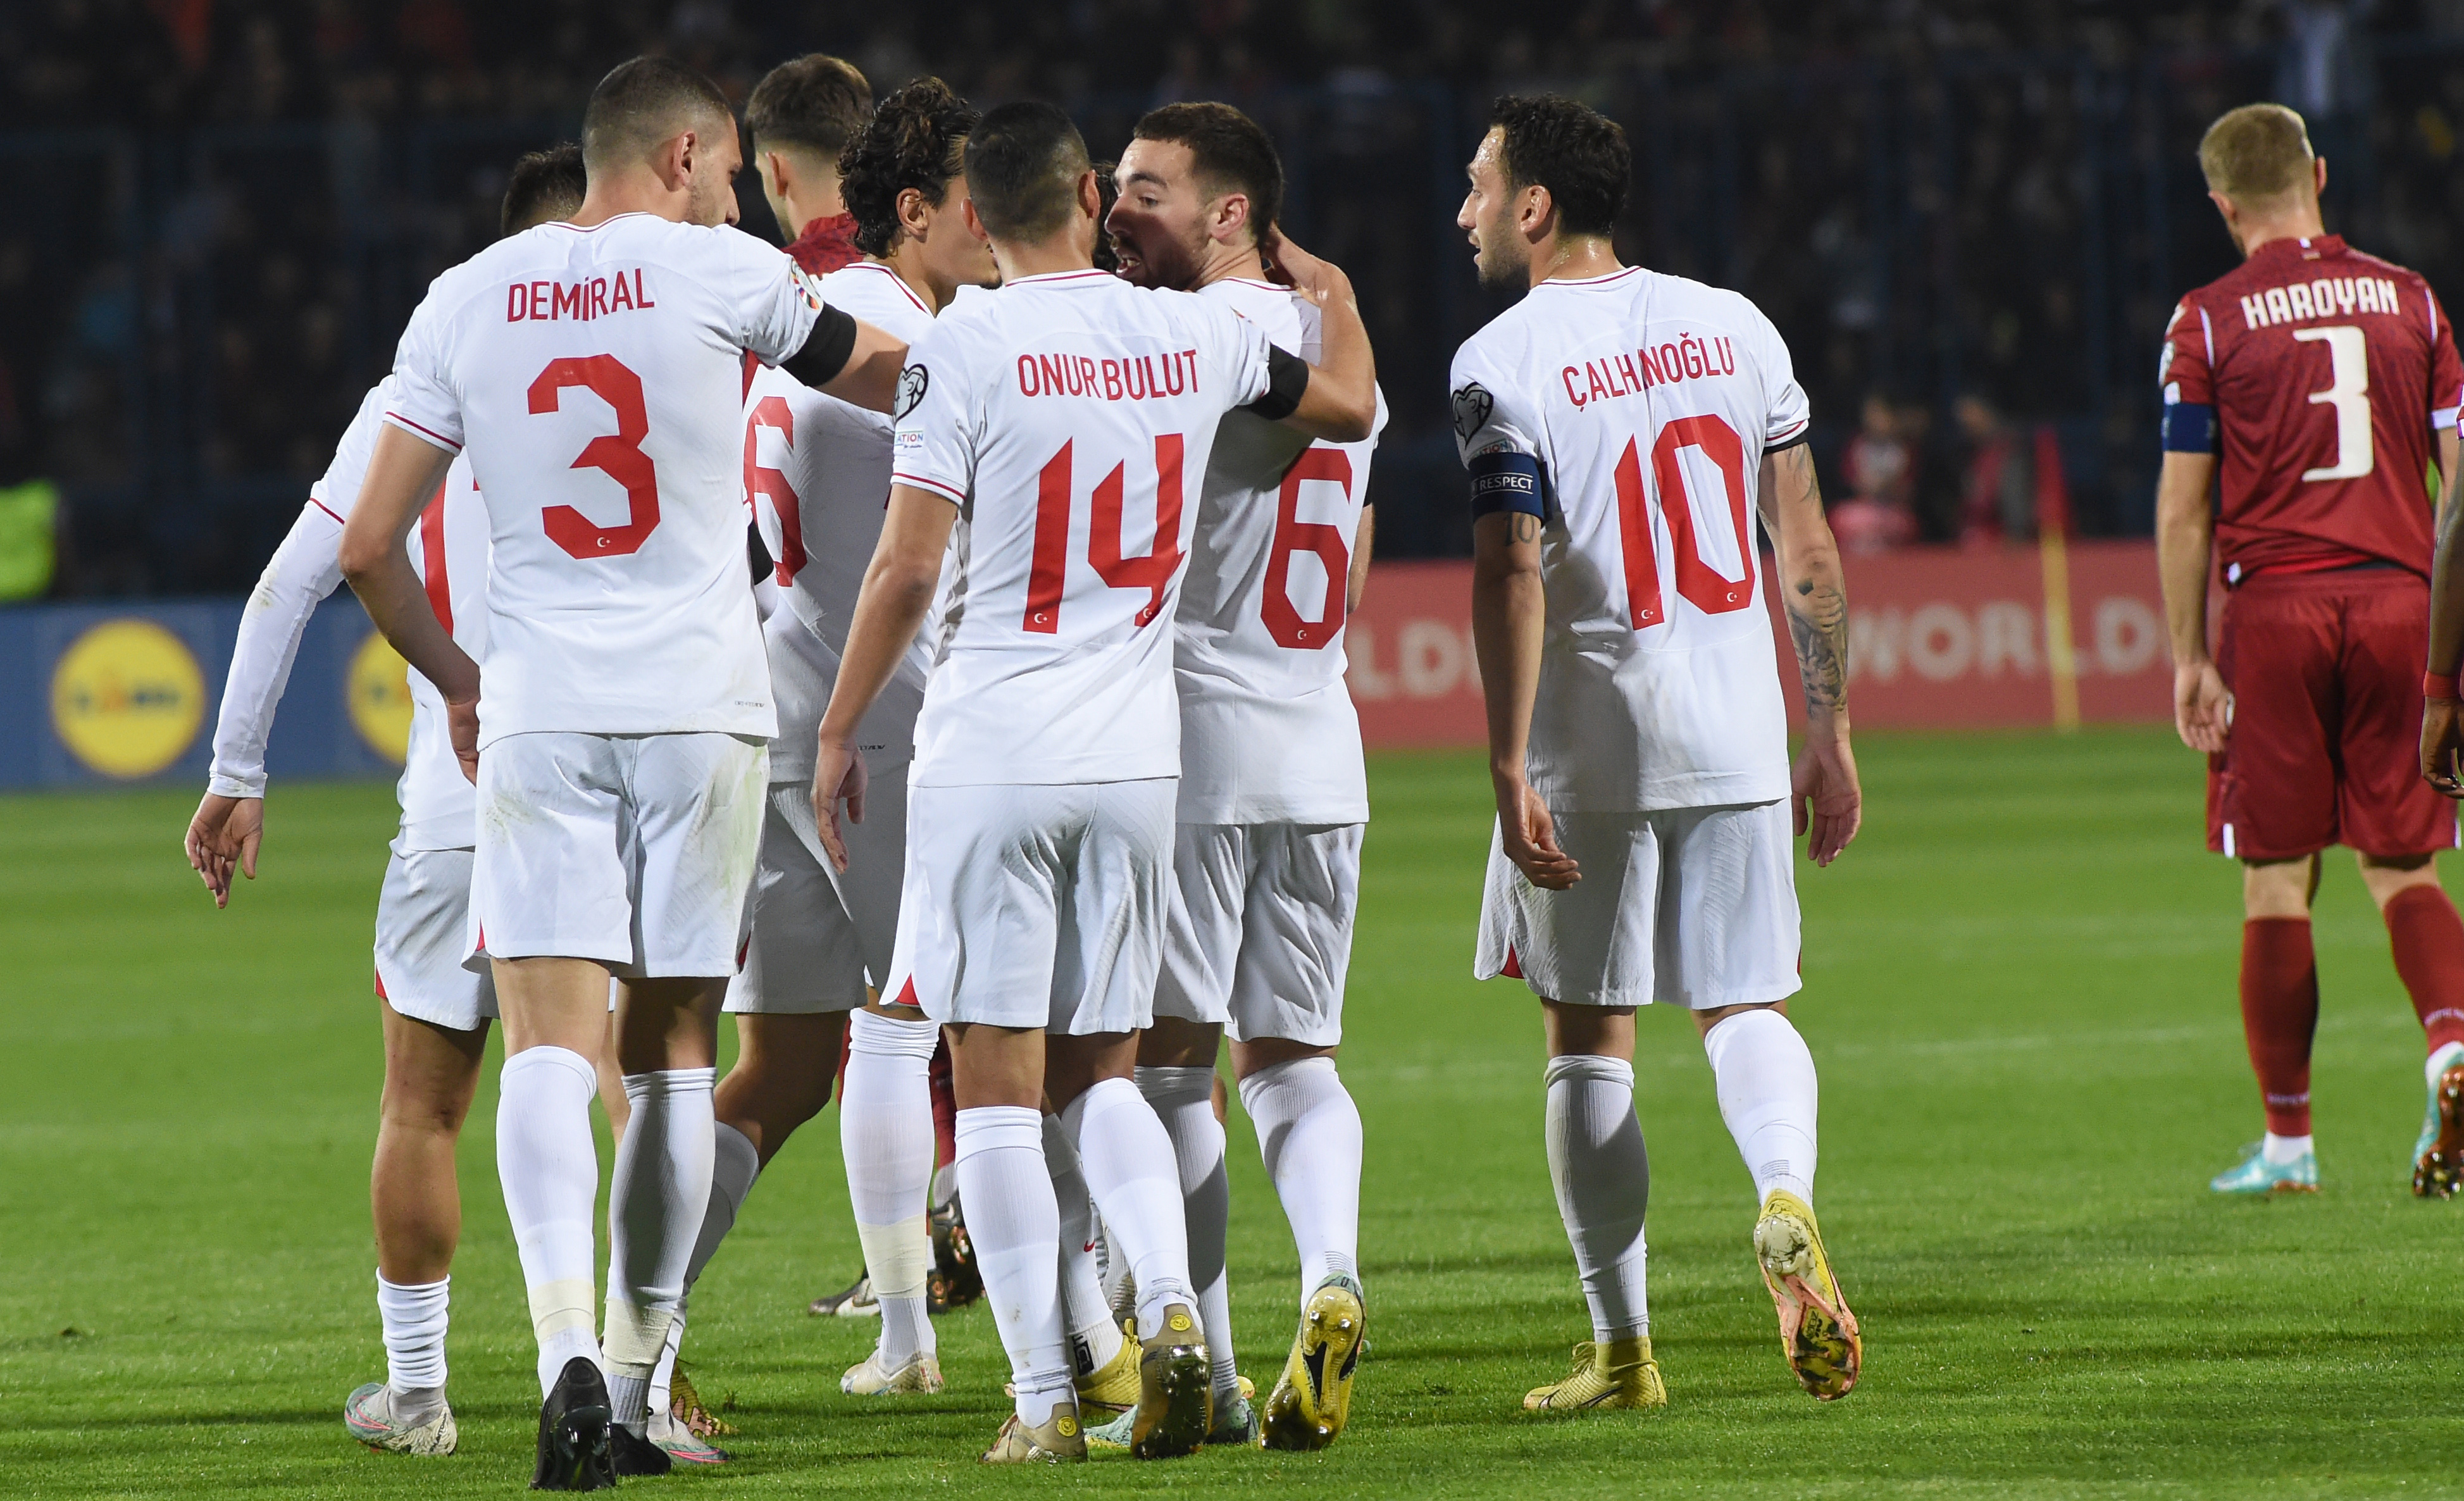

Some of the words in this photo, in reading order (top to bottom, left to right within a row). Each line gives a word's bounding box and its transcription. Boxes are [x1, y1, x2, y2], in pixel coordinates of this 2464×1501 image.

[1562, 331, 1736, 413] ÇALHNOĞLU
[2240, 276, 2401, 331] HAROYAN
[527, 353, 661, 560] 3
[1479, 476, 1533, 491] RESPECT
[2292, 325, 2374, 482] 3
[1022, 432, 1186, 635] 14
[1260, 447, 1353, 650] 6
[1614, 413, 1756, 630] 10
